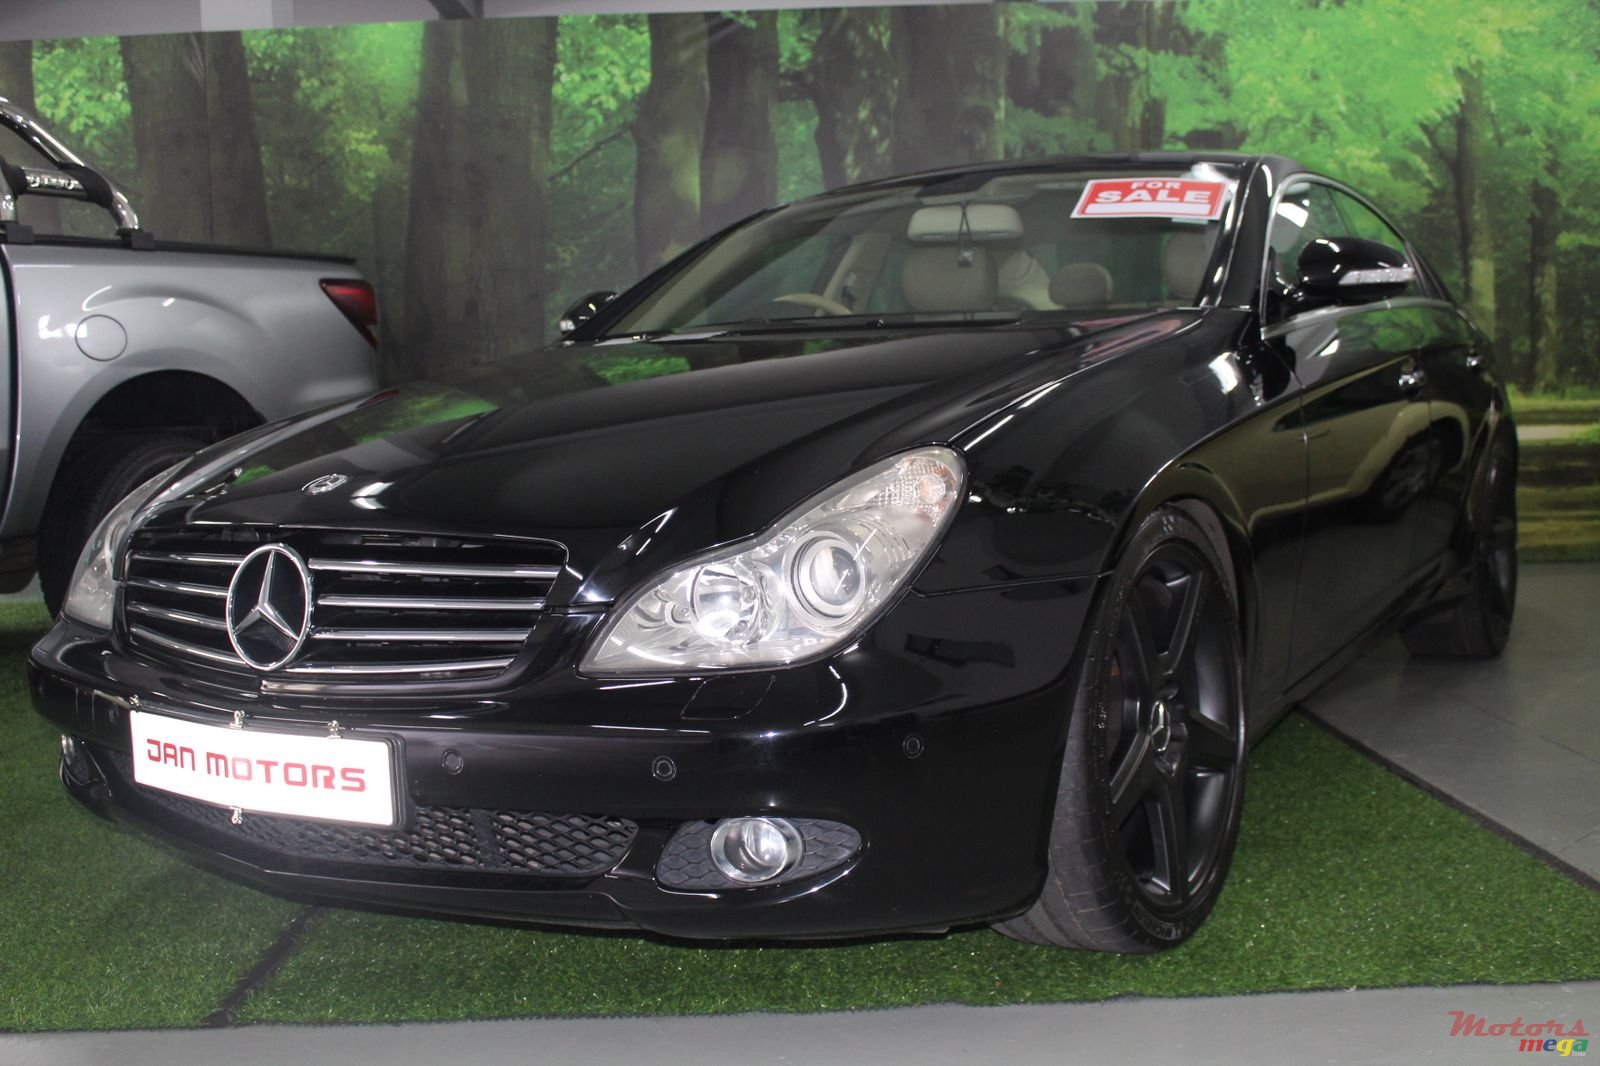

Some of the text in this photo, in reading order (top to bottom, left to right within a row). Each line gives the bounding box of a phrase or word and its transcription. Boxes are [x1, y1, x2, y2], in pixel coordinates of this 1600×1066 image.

[1130, 181, 1181, 190] FOR
[1095, 189, 1211, 203] SALE
[147, 738, 366, 793] JAN MOTORS
